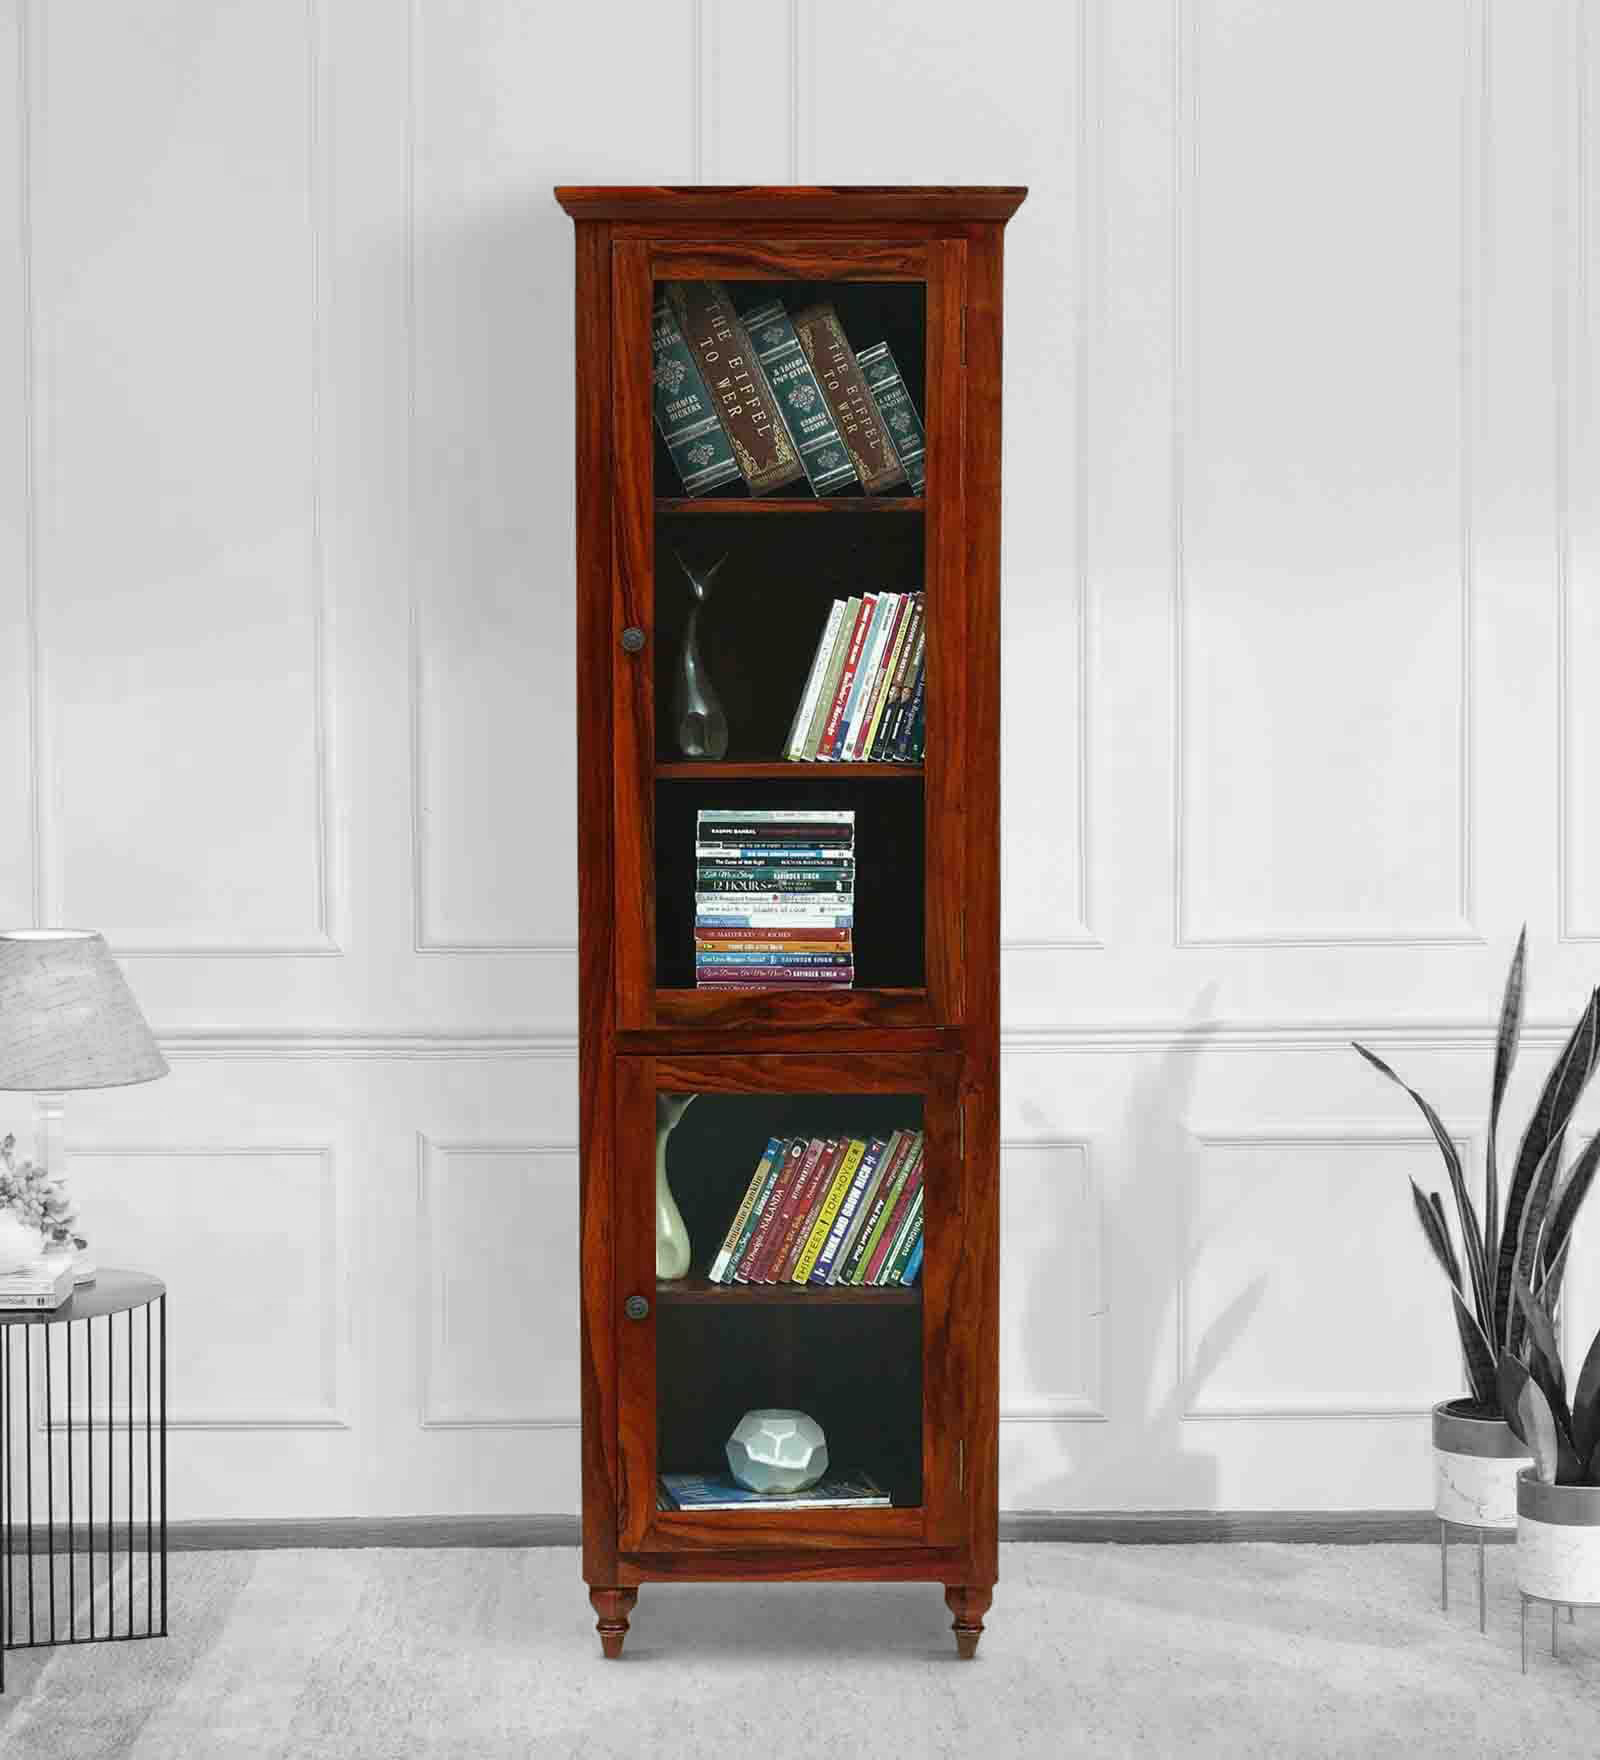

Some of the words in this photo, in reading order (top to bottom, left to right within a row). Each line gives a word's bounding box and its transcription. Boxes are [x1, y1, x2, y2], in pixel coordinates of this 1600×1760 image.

[706, 304, 732, 342] THE
[728, 356, 772, 436] EIFFEL
[828, 343, 848, 374] THE
[846, 385, 881, 448] EIFFEL
[666, 394, 698, 413] CHARLES
[670, 403, 702, 421] DICKENS
[725, 880, 768, 890] HOURS
[726, 1209, 748, 1248] Benjamin
[744, 1176, 762, 1210] Franklin
[760, 1189, 784, 1230] NALANDA
[796, 1227, 824, 1280] THIRTEEN
[824, 1194, 839, 1216] TOM
[836, 1156, 856, 1192] HOYLE
[821, 1235, 840, 1263] THINK
[832, 1216, 848, 1235] AND
[842, 1188, 860, 1217] GROW
[854, 1164, 872, 1188] RICH
[902, 1216, 924, 1256] Politicians
